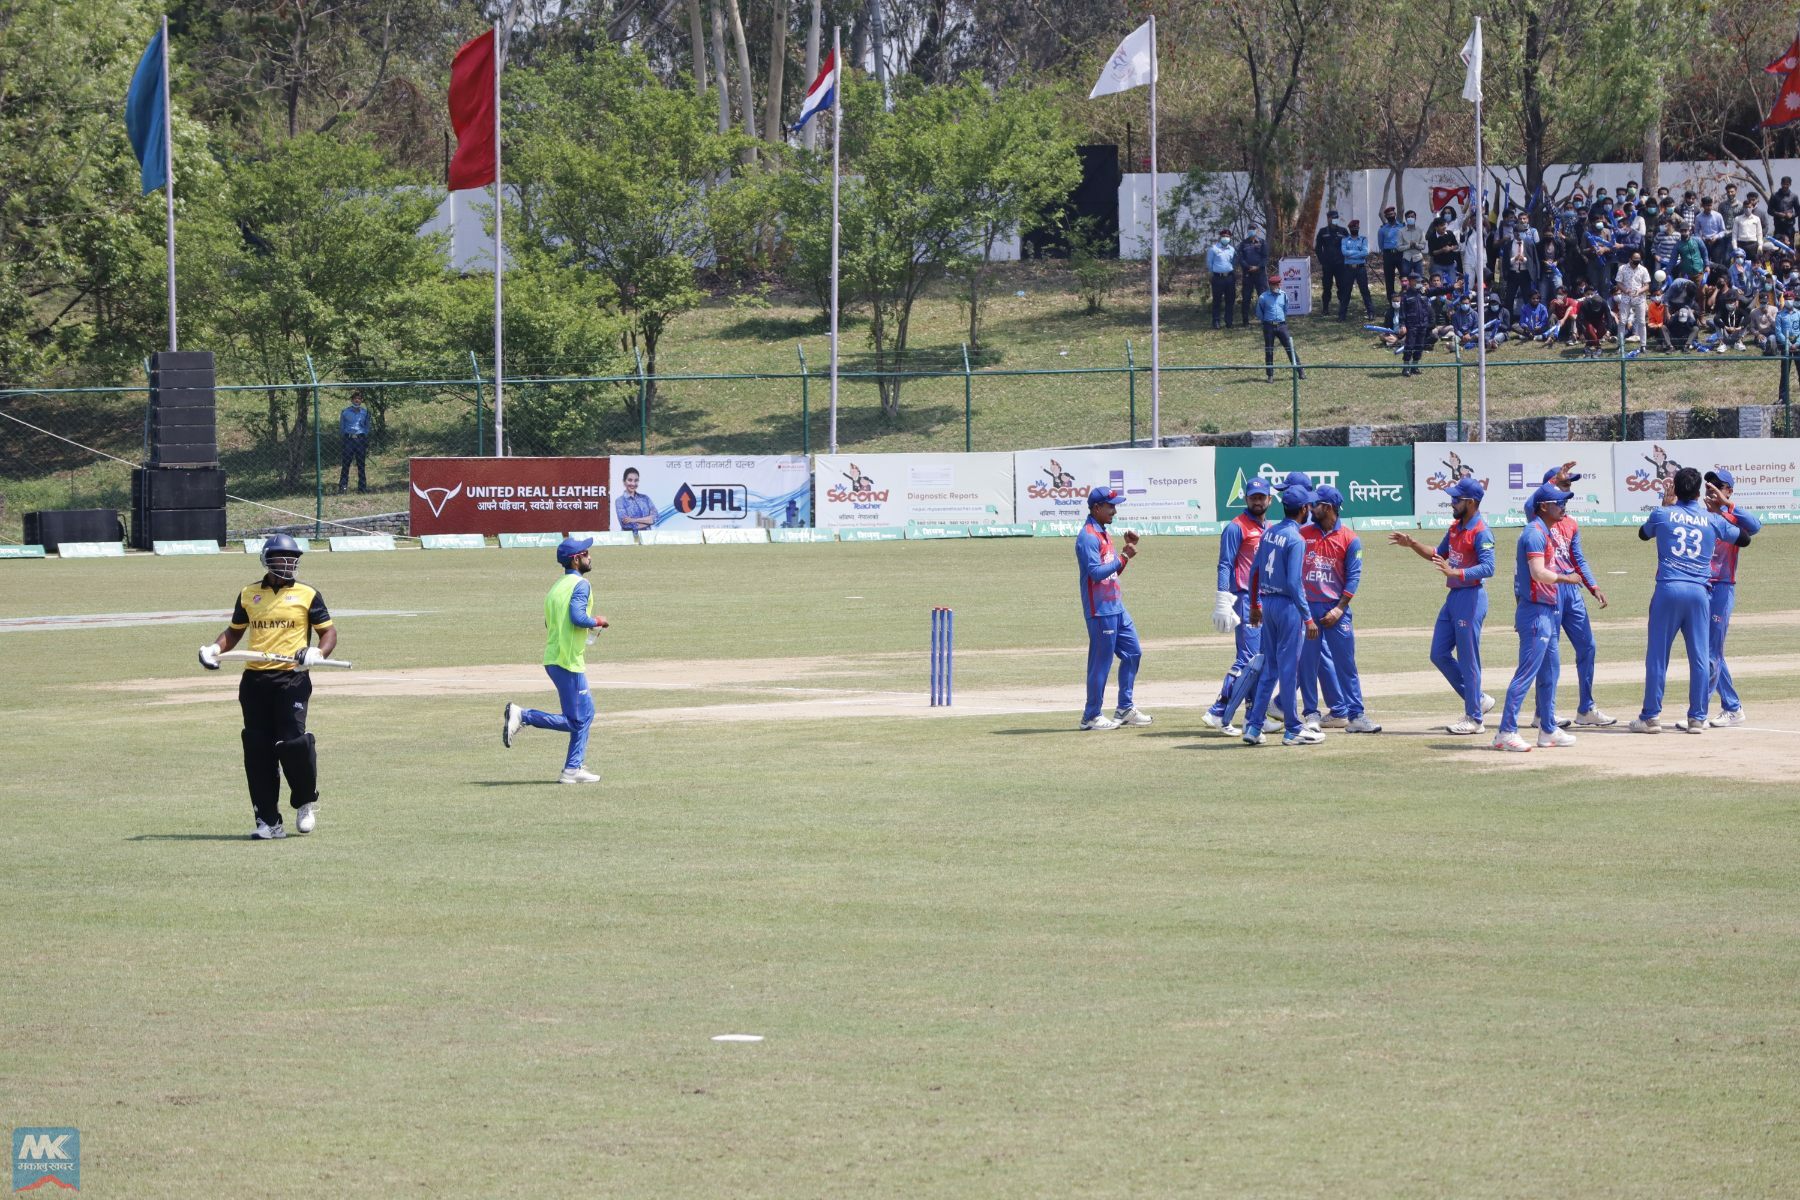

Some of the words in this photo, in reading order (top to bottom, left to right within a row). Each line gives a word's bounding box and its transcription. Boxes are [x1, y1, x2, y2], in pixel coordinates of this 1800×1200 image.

[1714, 462, 1742, 471] Smart
[1745, 462, 1786, 473] Learning
[1788, 462, 1796, 471] &
[1434, 471, 1447, 480] My
[1635, 469, 1650, 480] My
[1759, 475, 1795, 484] Partner
[1035, 480, 1048, 488] My
[1148, 476, 1198, 487] Testpapers
[466, 485, 515, 498] UNITED
[517, 485, 549, 498] REAL
[551, 485, 607, 498] LEATHER
[834, 483, 848, 492] My
[1027, 485, 1091, 499] Second
[1348, 479, 1403, 502] सिमेन्ट
[826, 489, 890, 503] Second
[907, 492, 947, 501] Diagnostic
[949, 491, 979, 500] Reports
[529, 499, 555, 511] स्वदेशी
[584, 500, 599, 511] शान
[696, 488, 742, 517] JAL
[853, 502, 881, 510] Teacher
[1054, 498, 1082, 506] Teacher
[1669, 512, 1709, 527] KARAN
[1264, 532, 1287, 548] ALAM
[1670, 526, 1704, 560] 33
[1265, 549, 1276, 580] 4
[251, 620, 296, 630] MALAYSIA
